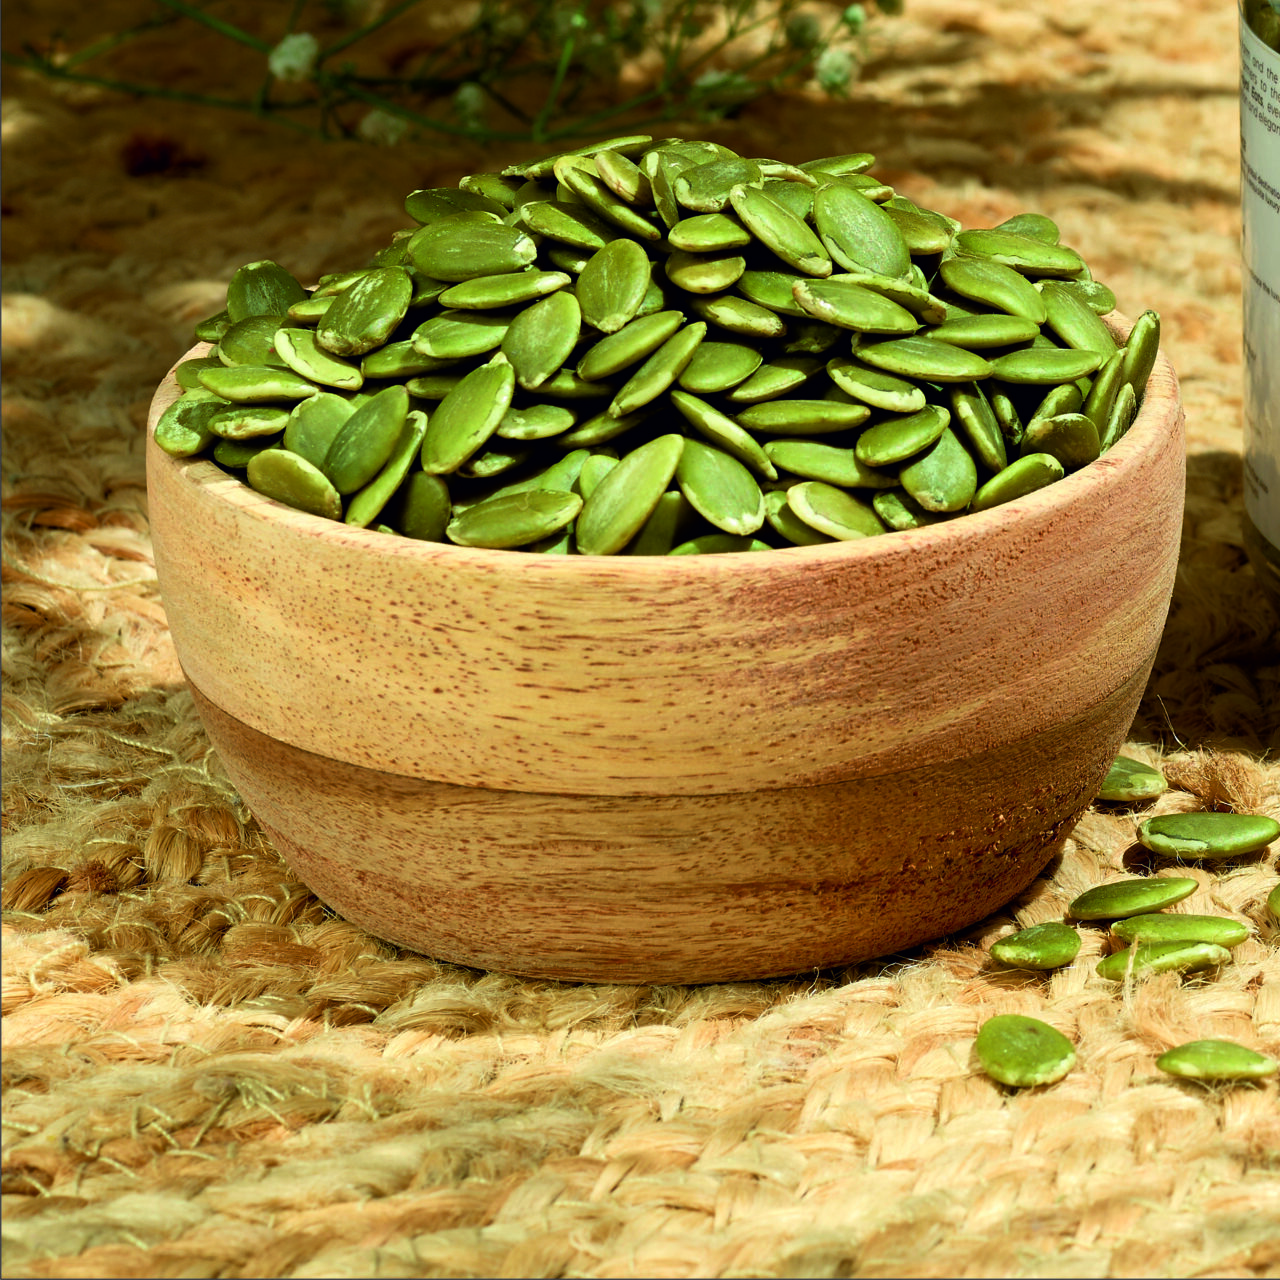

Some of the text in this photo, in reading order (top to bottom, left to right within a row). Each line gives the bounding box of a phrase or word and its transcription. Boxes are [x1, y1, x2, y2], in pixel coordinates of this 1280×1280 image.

[1252, 57, 1264, 73] and
[1266, 67, 1279, 84] the
[1260, 79, 1268, 93] to
